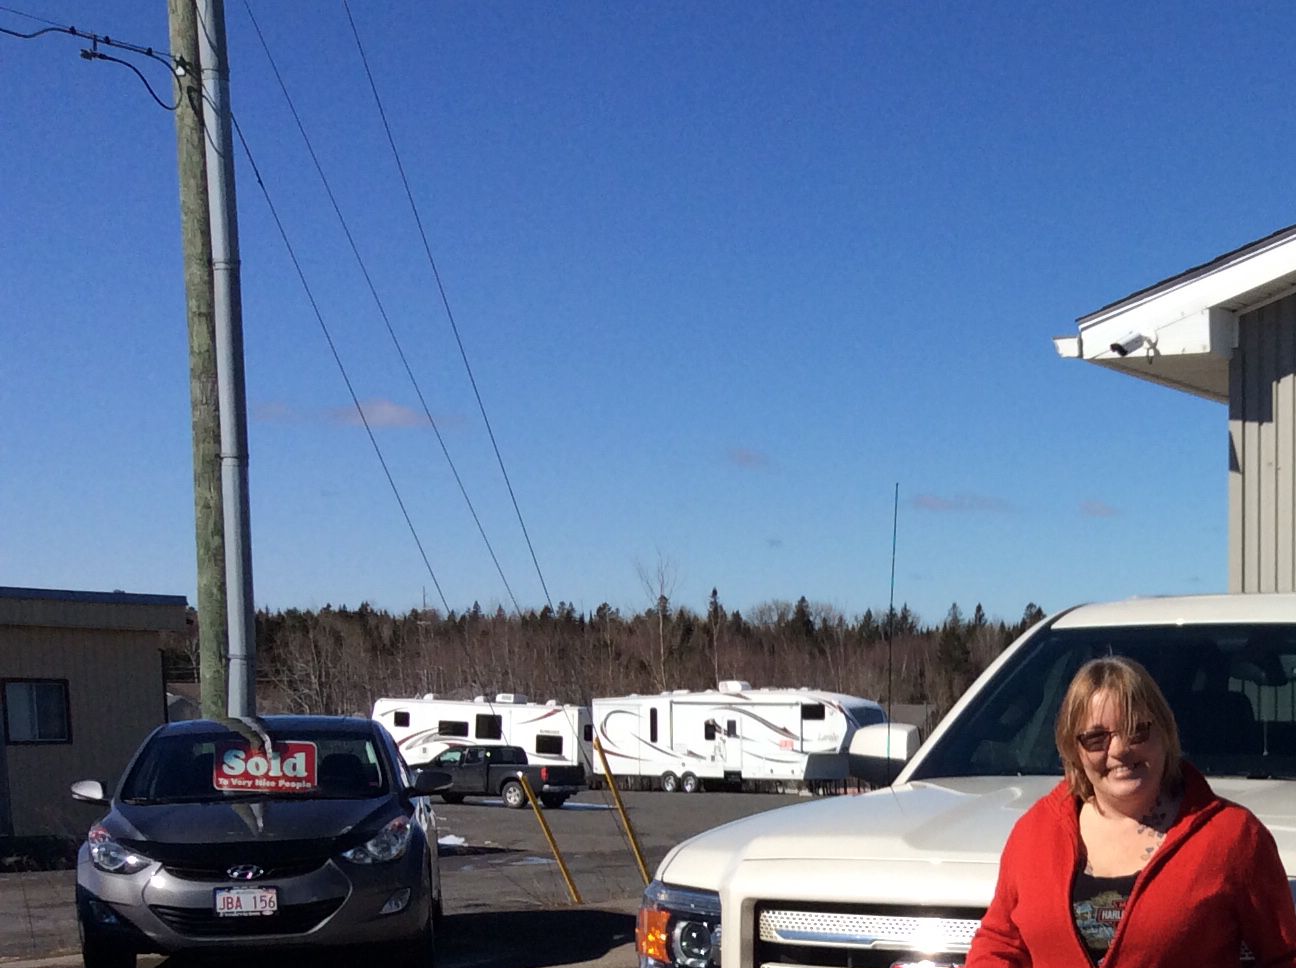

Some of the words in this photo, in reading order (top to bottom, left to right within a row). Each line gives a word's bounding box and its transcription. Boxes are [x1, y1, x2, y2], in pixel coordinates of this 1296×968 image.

[222, 749, 308, 777] Sold
[231, 779, 253, 788] Very
[219, 896, 242, 910] JBA
[253, 895, 275, 909] 156
